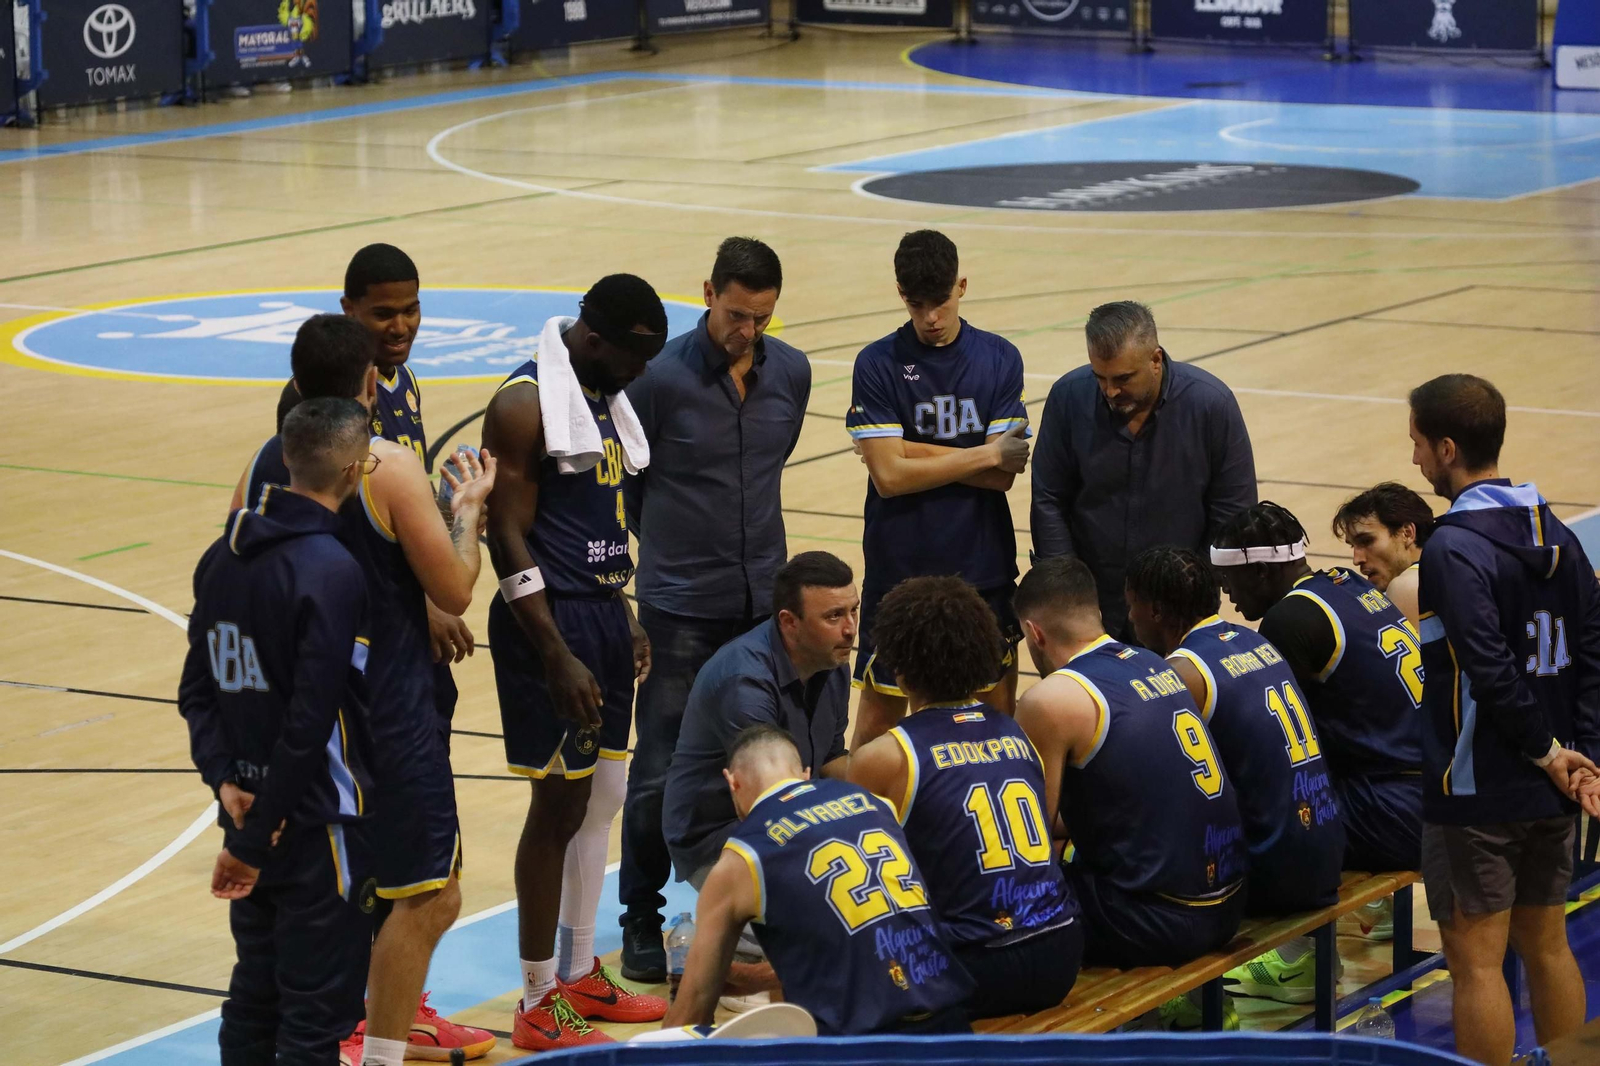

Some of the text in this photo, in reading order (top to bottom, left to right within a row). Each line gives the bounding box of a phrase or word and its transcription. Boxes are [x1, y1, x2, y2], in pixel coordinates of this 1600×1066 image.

[86, 64, 136, 86] TOMAX
[914, 394, 984, 440] CBA
[616, 489, 627, 531] 4
[1172, 708, 1224, 800] 9
[1265, 680, 1322, 768] 11
[764, 792, 878, 847] ÁLVAREZ
[963, 778, 1051, 875] 10
[805, 828, 931, 936] 22
